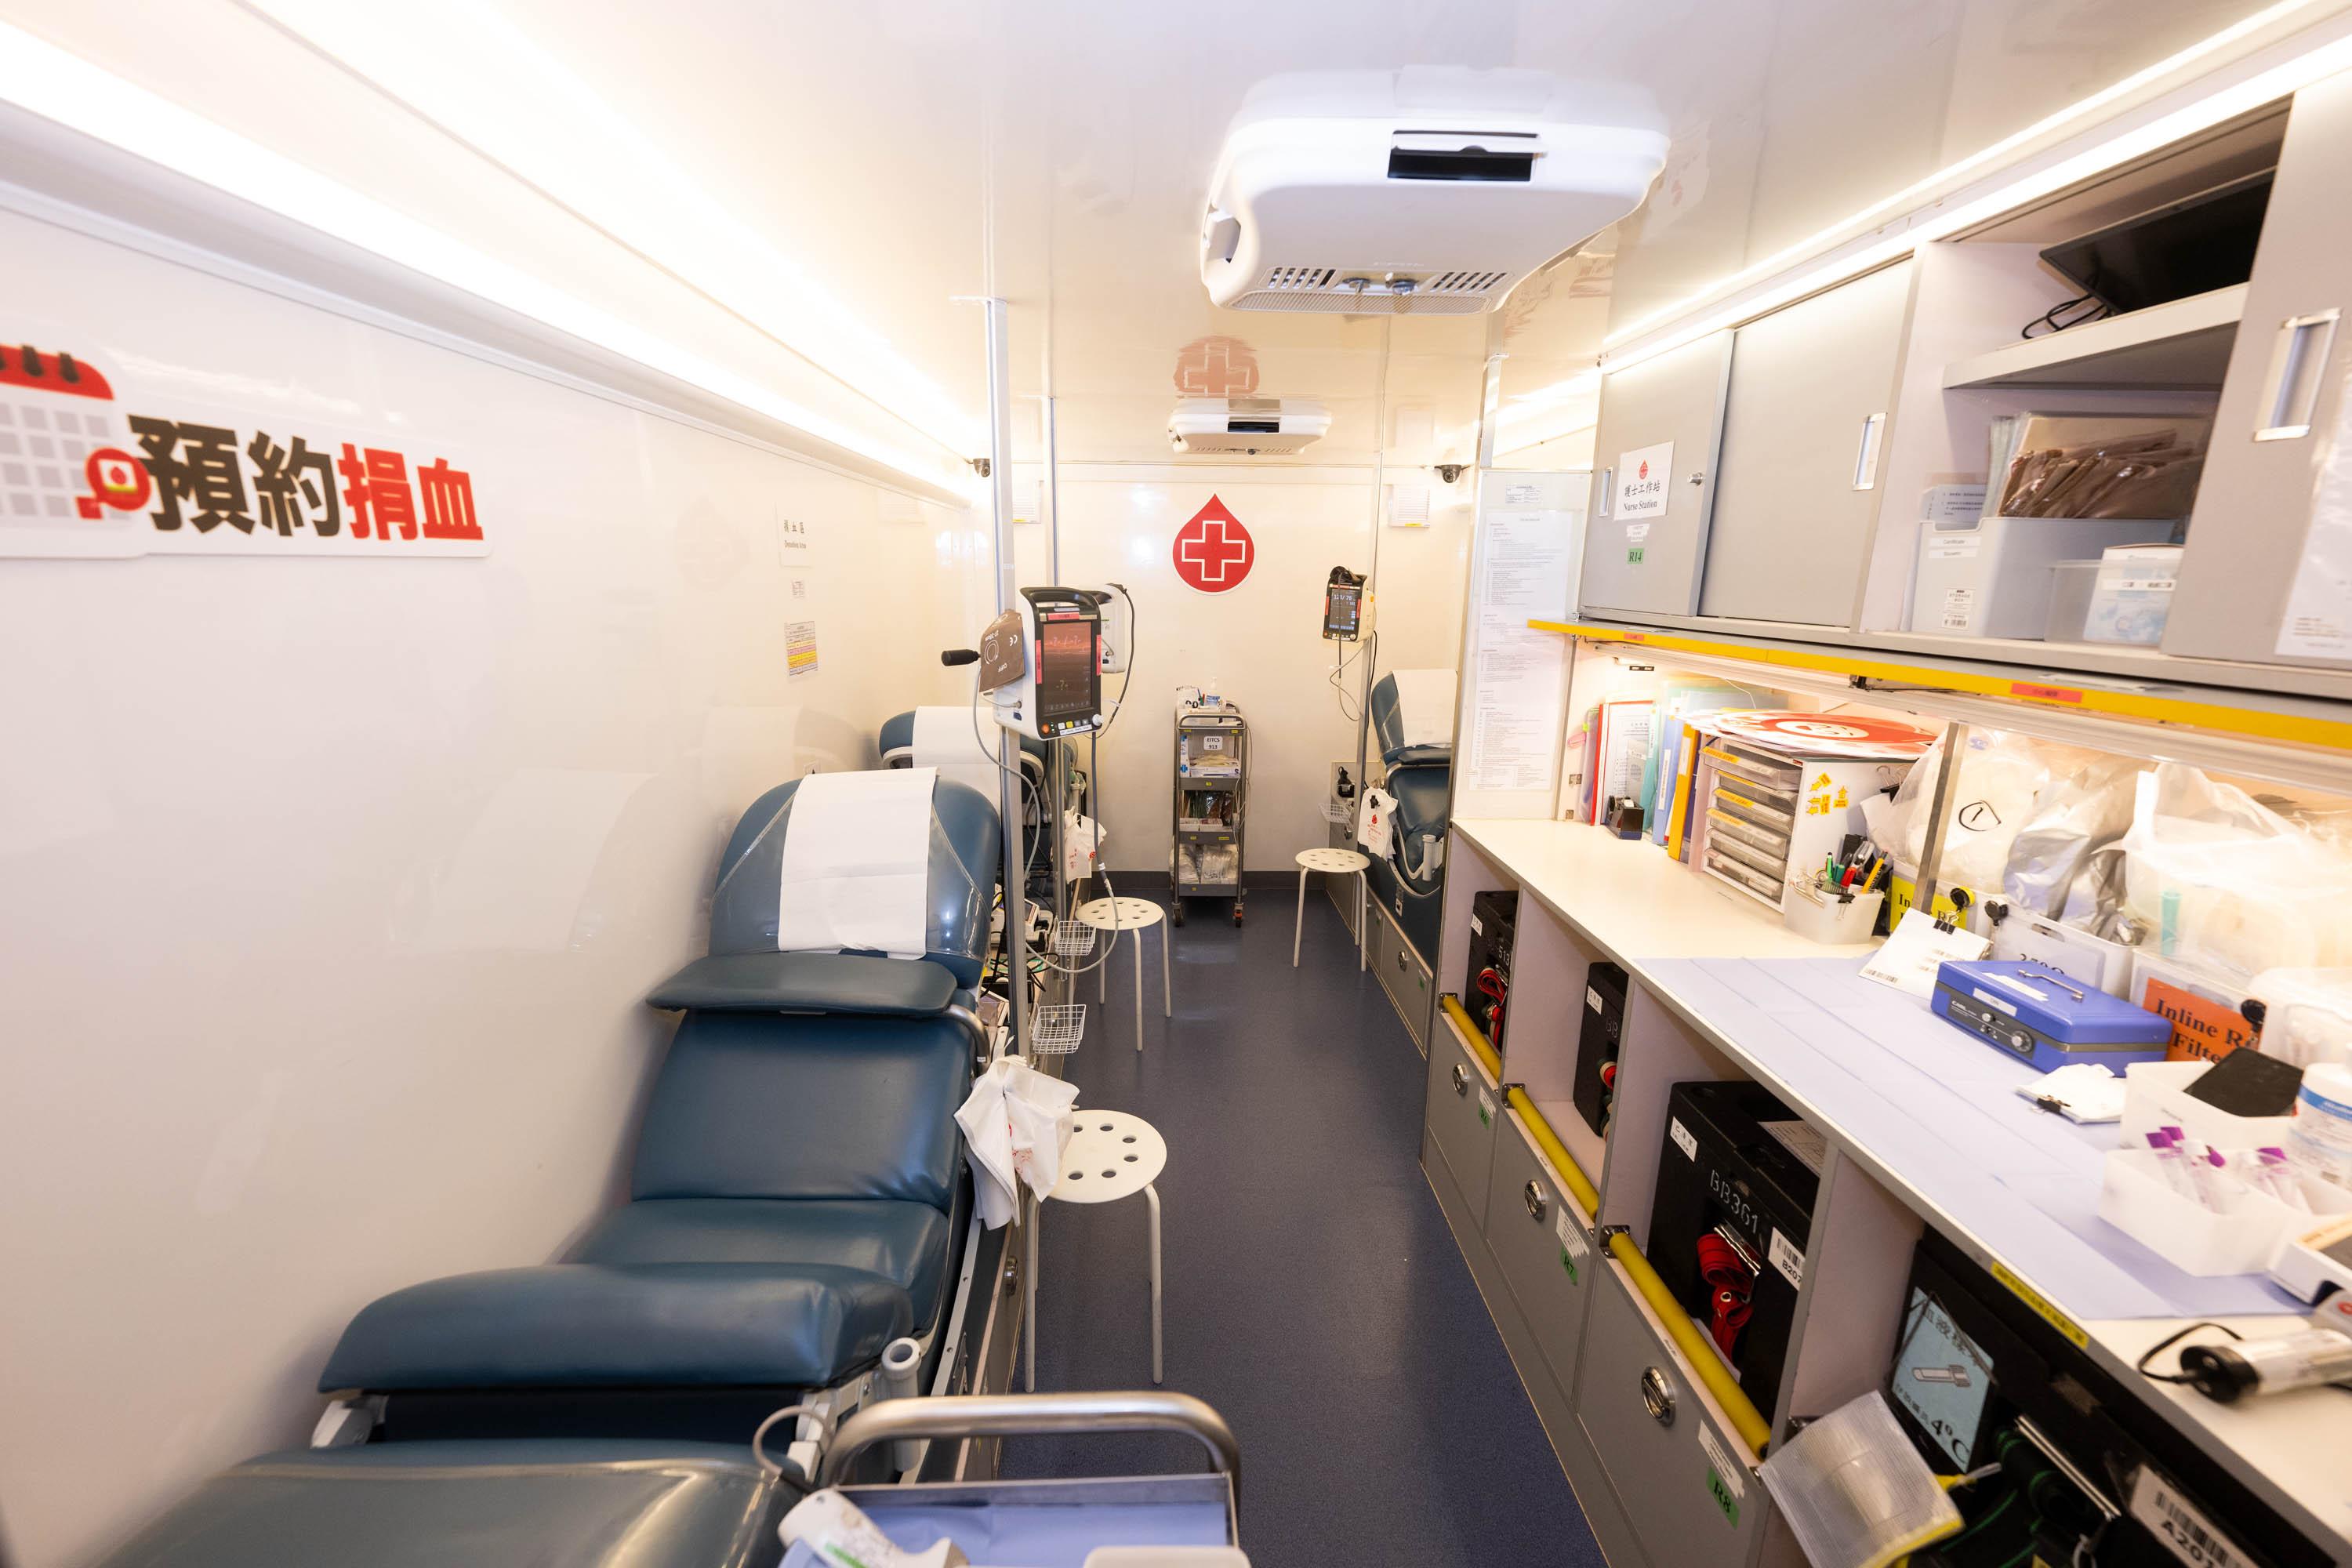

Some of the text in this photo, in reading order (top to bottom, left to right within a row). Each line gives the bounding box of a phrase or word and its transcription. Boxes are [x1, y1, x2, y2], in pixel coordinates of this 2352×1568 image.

[125, 414, 485, 541] 預約捐血
[1624, 499, 1657, 512] Nurse Station
[1628, 550, 1642, 562] R14
[2157, 998, 2219, 1038] Inline
[2171, 1032, 2221, 1065] Filte
[1709, 1168, 1758, 1235] BB361
[1781, 1258, 1802, 1283] B207
[1714, 1479, 1731, 1514] R8
